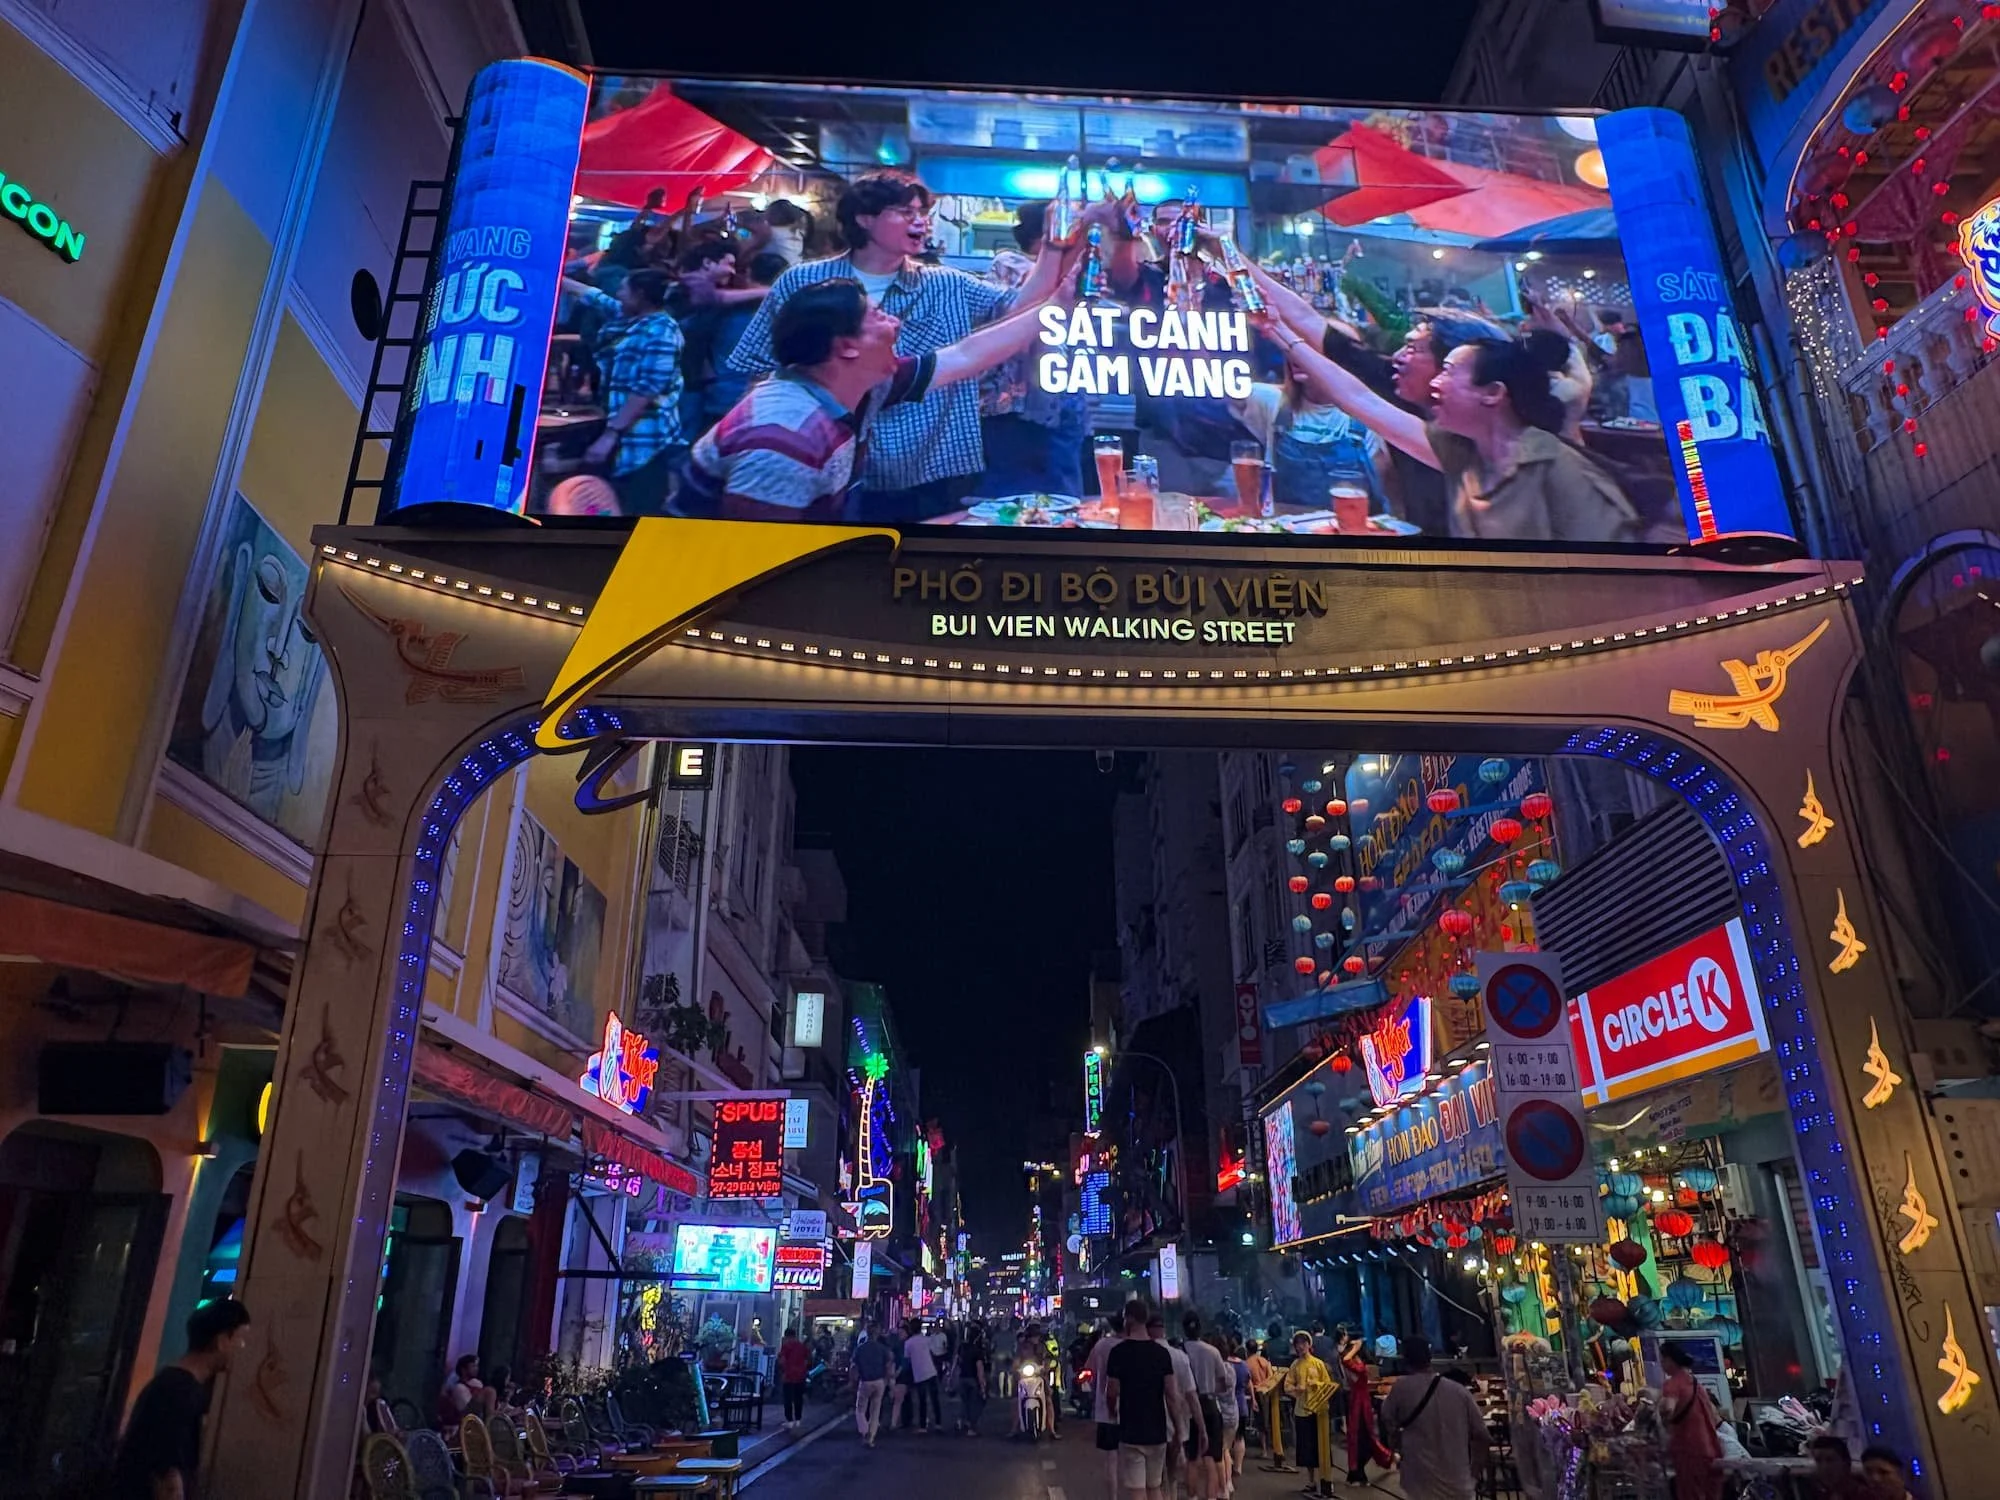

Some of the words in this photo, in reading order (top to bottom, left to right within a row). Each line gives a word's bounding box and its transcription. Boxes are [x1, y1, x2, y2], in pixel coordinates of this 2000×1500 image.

[437, 261, 524, 326] ỨC
[1657, 266, 1718, 303] SÁT
[1039, 301, 1121, 347] SÁT
[1129, 305, 1249, 352] CÁNH
[1039, 348, 1129, 395] GẦM
[1138, 357, 1251, 398] VANG
[893, 559, 983, 602] PHỐ
[1000, 572, 1043, 602] ĐI
[1060, 566, 1118, 611] BỘ
[1135, 567, 1205, 607] BÙI
[1221, 571, 1328, 614] VIỆN
[931, 614, 977, 637] BUI
[987, 615, 1055, 638] VIEN
[1063, 615, 1196, 641] WALKING
[1202, 620, 1295, 643] STREET
[680, 749, 703, 775] E
[1603, 983, 1692, 1052] CIRCLE
[1692, 962, 1731, 1026] K
[1373, 1015, 1412, 1081] Tiger
[1508, 1053, 1528, 1064] 6:00
[1538, 1053, 1558, 1064] 9:00
[622, 1029, 659, 1102] Tiger
[1506, 1073, 1530, 1086] 16:00
[1541, 1073, 1566, 1086] 19:00
[1469, 1062, 1499, 1129] VI
[722, 1103, 777, 1122] SPUB
[732, 1140, 762, 1158] 풍선
[714, 1162, 743, 1178] 소녀
[748, 1162, 778, 1178] 점프
[1526, 1196, 1547, 1208] 9:00
[1559, 1196, 1584, 1208] 16:00
[1530, 1218, 1554, 1231] 19:00
[1566, 1218, 1586, 1230] 6:00
[774, 1268, 821, 1284] ATTOO
